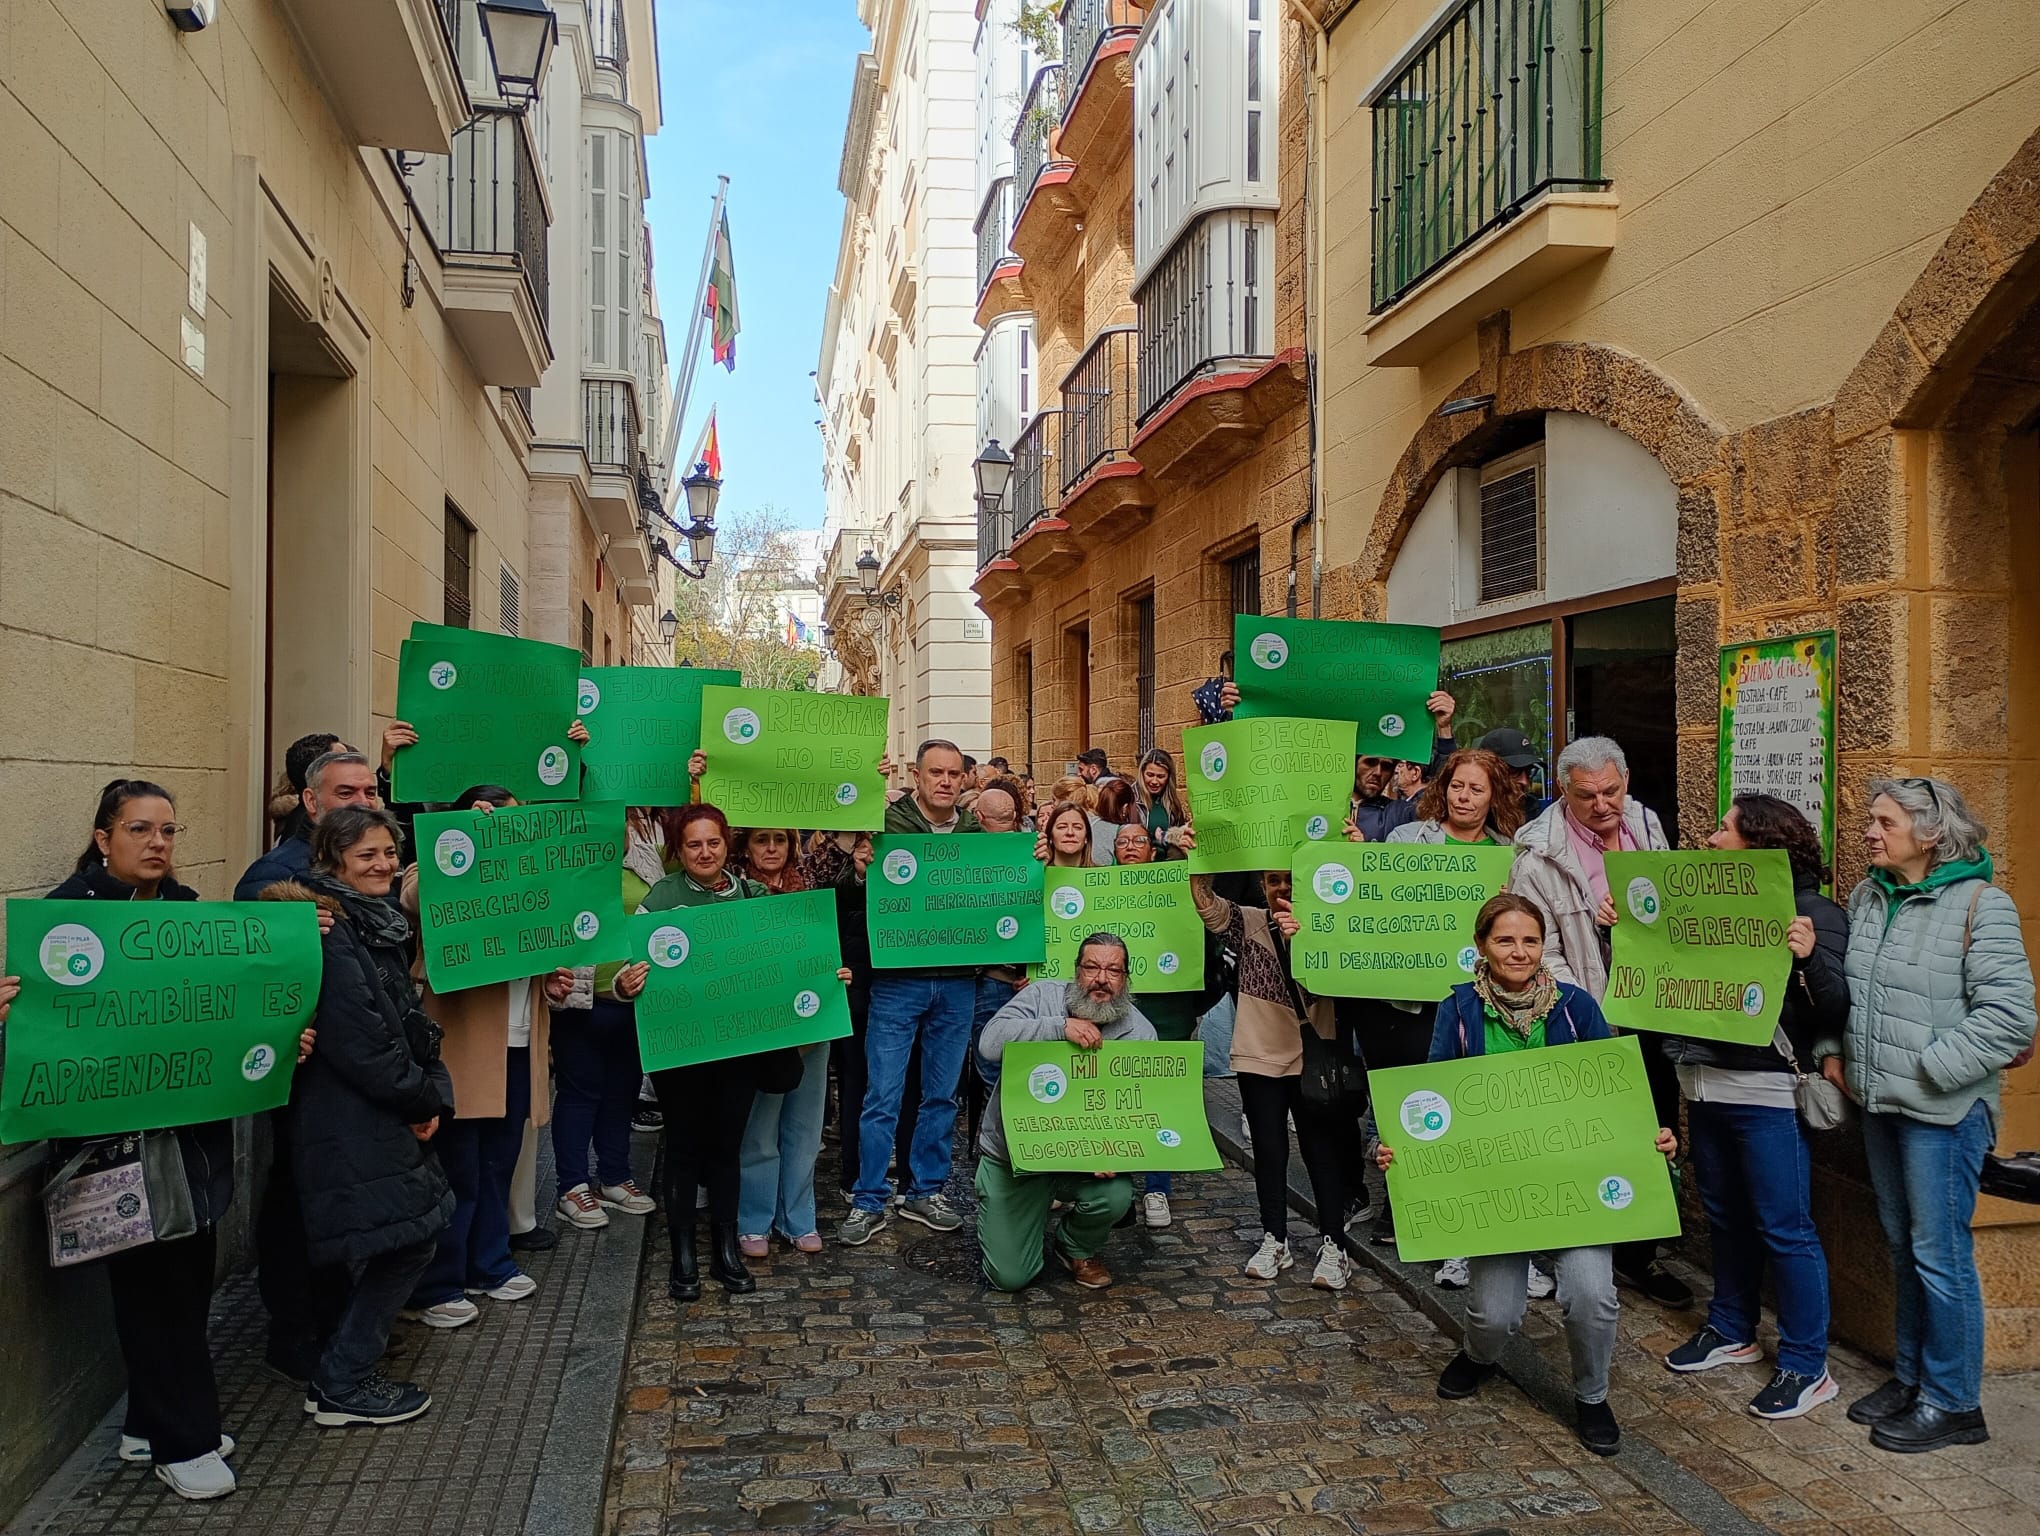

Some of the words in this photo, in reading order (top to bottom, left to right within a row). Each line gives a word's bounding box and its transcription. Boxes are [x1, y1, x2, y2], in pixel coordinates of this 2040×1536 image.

[1292, 627, 1423, 656] RECORTAR
[1286, 662, 1309, 681] EL
[1316, 662, 1424, 683] COMEDOR
[1736, 660, 1773, 684] BUENOS
[768, 695, 888, 737] RECORTAR
[1250, 720, 1331, 752] BECA
[776, 748, 814, 770] NO
[830, 747, 863, 770] ES
[1250, 752, 1348, 776] COMEDOR
[707, 778, 840, 813] GESTIONAR
[1192, 784, 1289, 815] TERAPIA
[1307, 784, 1333, 801] DE
[473, 809, 588, 849] TERAPIA
[479, 859, 509, 883] EN
[519, 856, 539, 875] EL
[546, 842, 616, 871] PLATO
[923, 842, 960, 862] LOS
[1362, 851, 1476, 872] RECORTAR
[927, 864, 1028, 885] CUBIERTOS
[1085, 872, 1110, 887] EN
[1663, 862, 1758, 897] COMER
[878, 897, 911, 914] SON
[925, 889, 1043, 911] HERRAMIENTAS
[1093, 891, 1177, 910] ESPECIAL
[1359, 883, 1383, 900] EL
[1391, 883, 1485, 901] COMEDOR
[430, 889, 550, 928] DERECHOS
[693, 909, 739, 944] SIN
[751, 898, 821, 932] BECA
[1311, 913, 1335, 933] ES
[1348, 914, 1457, 933] RECORTAR
[120, 917, 271, 960] COMER
[443, 943, 471, 967] EN
[483, 937, 505, 957] EL
[518, 924, 575, 953] AULA
[1667, 916, 1783, 947] DERECHO
[689, 952, 718, 975] DE
[726, 932, 806, 965] COMEDOR
[1036, 958, 1060, 978] ES
[1305, 951, 1328, 969] MI
[1340, 951, 1448, 970] DESARROLLO
[641, 984, 692, 1017] NOS
[705, 962, 784, 1000] QUITAN
[797, 954, 836, 978] UNA
[1614, 966, 1645, 998] NO
[54, 979, 236, 1028] TAMBIEN
[263, 983, 302, 1017] ES
[647, 1020, 706, 1055] HORA
[713, 1001, 801, 1041] ESENCIAL
[21, 1048, 213, 1107] APRENDER
[1071, 1048, 1098, 1079] MI
[1110, 1055, 1187, 1078] CUCHARA
[1084, 1089, 1106, 1111] ES
[1116, 1083, 1142, 1109] MI
[1454, 1053, 1632, 1117] COMEDOR
[1013, 1113, 1162, 1132] HERRAMIENTA
[1402, 1118, 1614, 1179] INDEPENCIA
[1405, 1181, 1591, 1239] FUTURA
